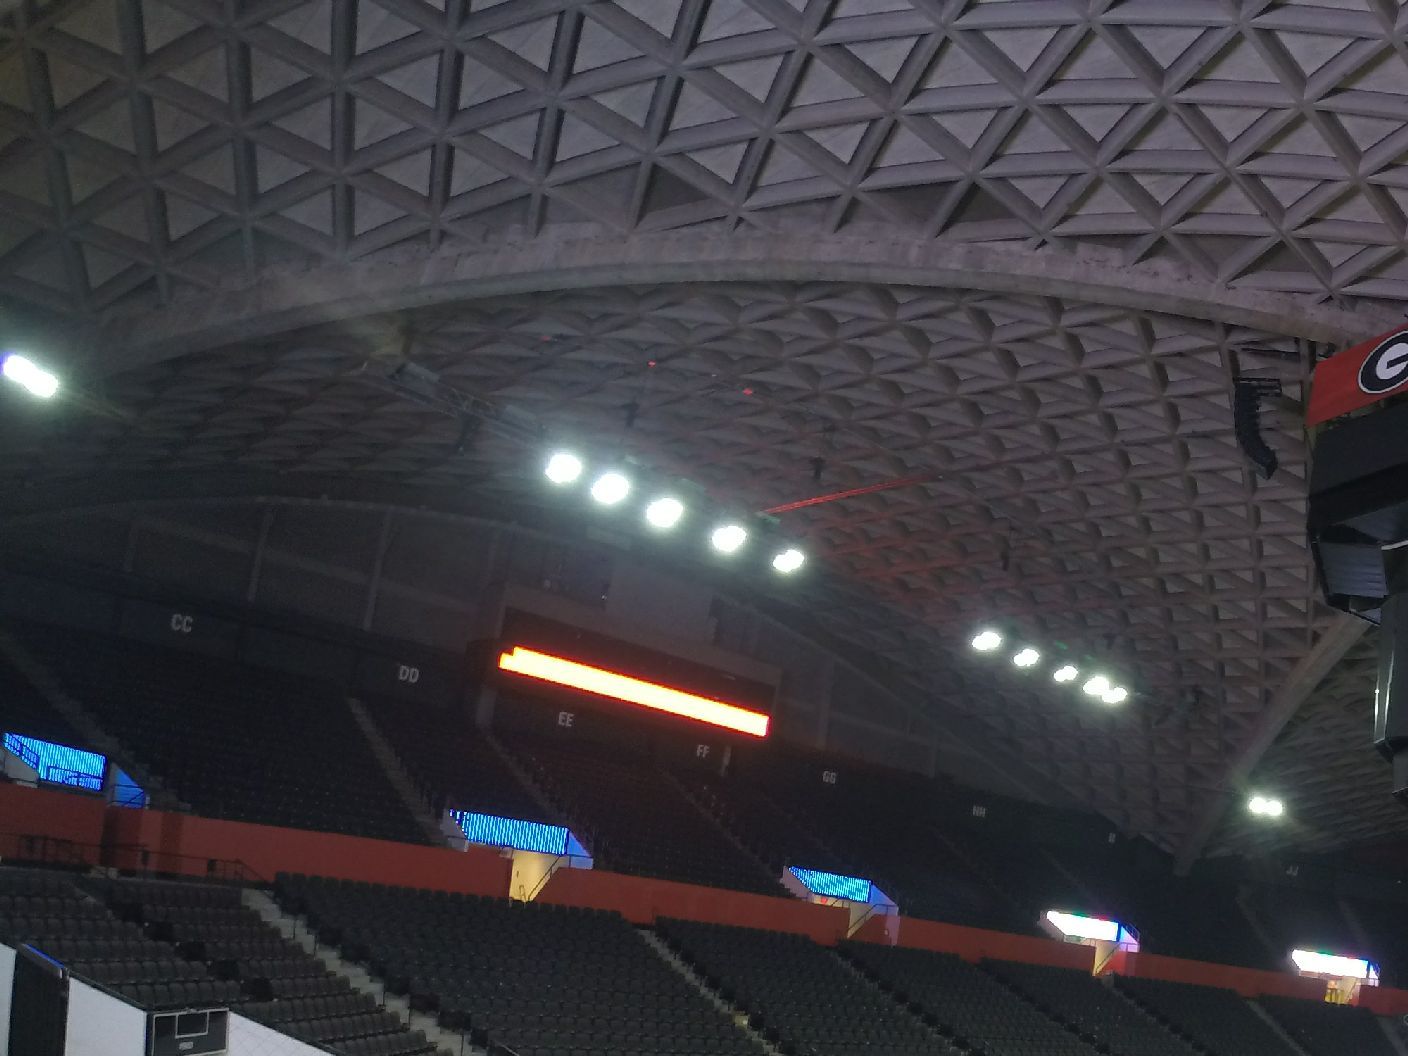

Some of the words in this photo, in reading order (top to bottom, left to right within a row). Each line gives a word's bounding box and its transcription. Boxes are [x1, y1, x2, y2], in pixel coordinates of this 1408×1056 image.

[171, 613, 193, 633] CC
[398, 664, 420, 684] DD
[557, 711, 575, 727] EE
[696, 744, 710, 758] FF
[822, 770, 837, 785] GG
